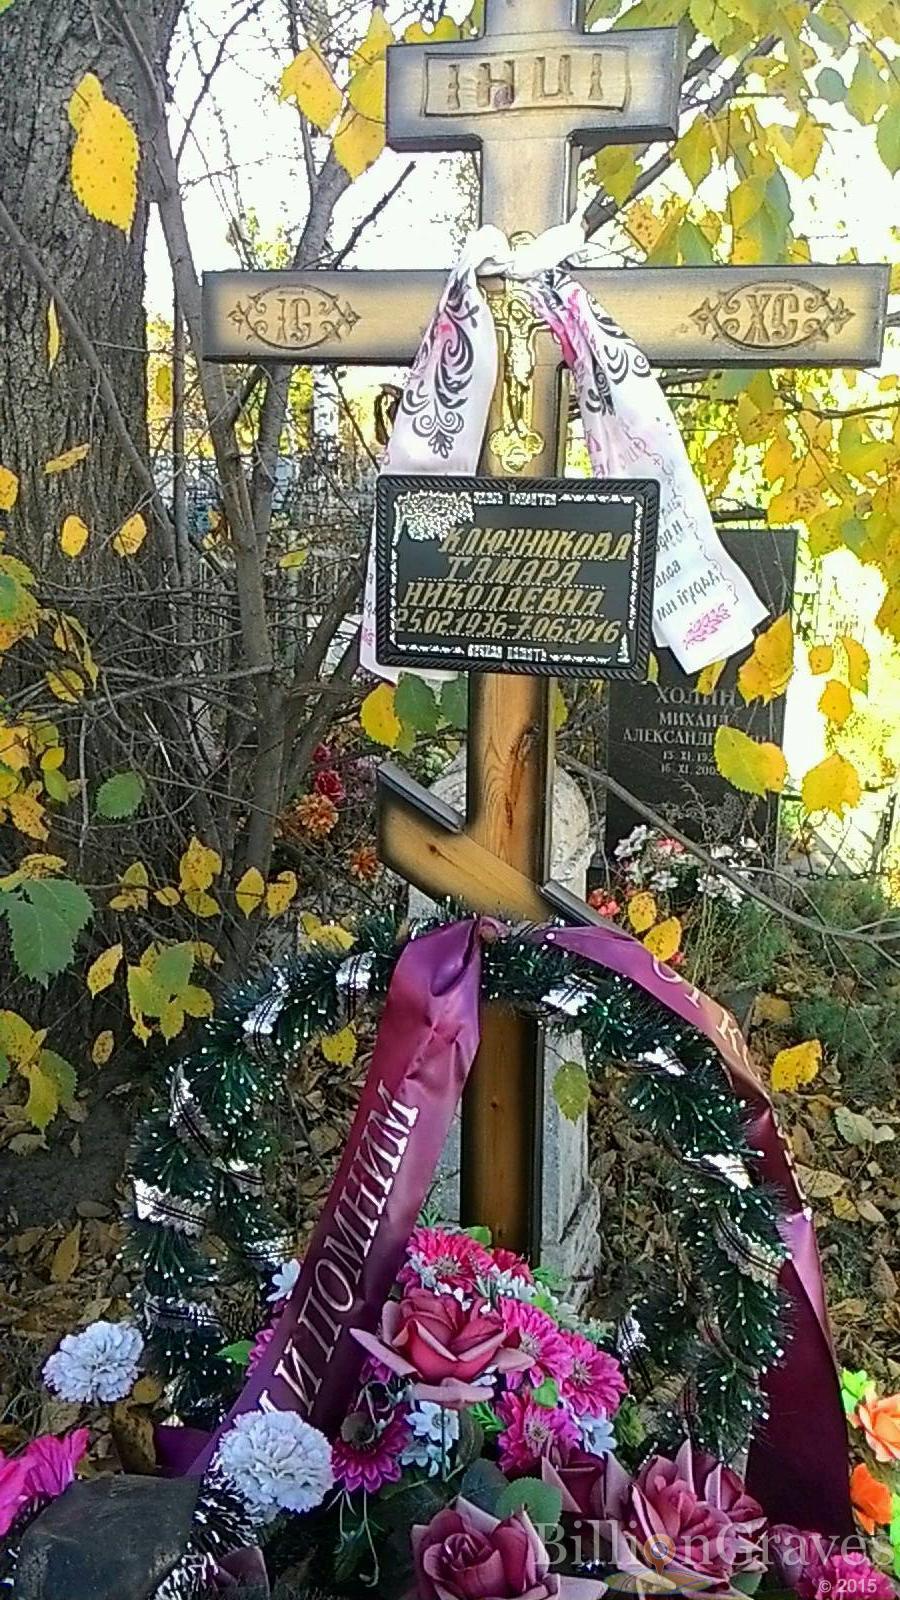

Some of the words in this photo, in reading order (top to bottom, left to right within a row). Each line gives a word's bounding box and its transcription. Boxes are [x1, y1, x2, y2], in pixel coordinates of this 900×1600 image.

[438, 526, 633, 560] КЛЮЧНИКОВА
[446, 556, 582, 585] ТАМАРА
[401, 582, 605, 614] НИКОЛАЕВНА
[297, 1080, 420, 1363] ПОМНИМ
